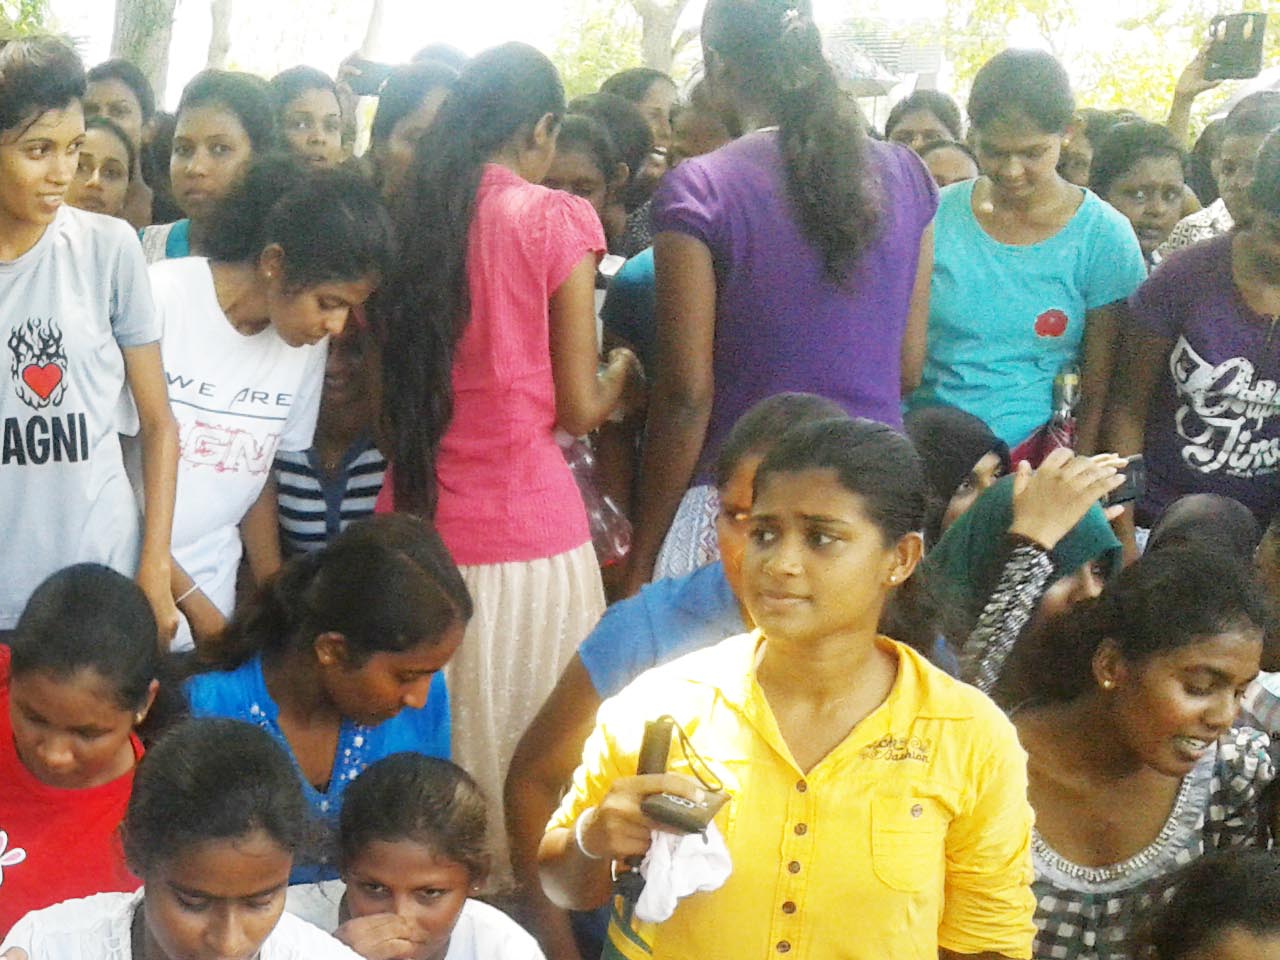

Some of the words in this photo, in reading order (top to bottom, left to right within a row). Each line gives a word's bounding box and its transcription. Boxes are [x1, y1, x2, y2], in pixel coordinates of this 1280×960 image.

[165, 372, 217, 397] WE
[228, 387, 293, 409] ARE
[2, 413, 89, 466] AGNI
